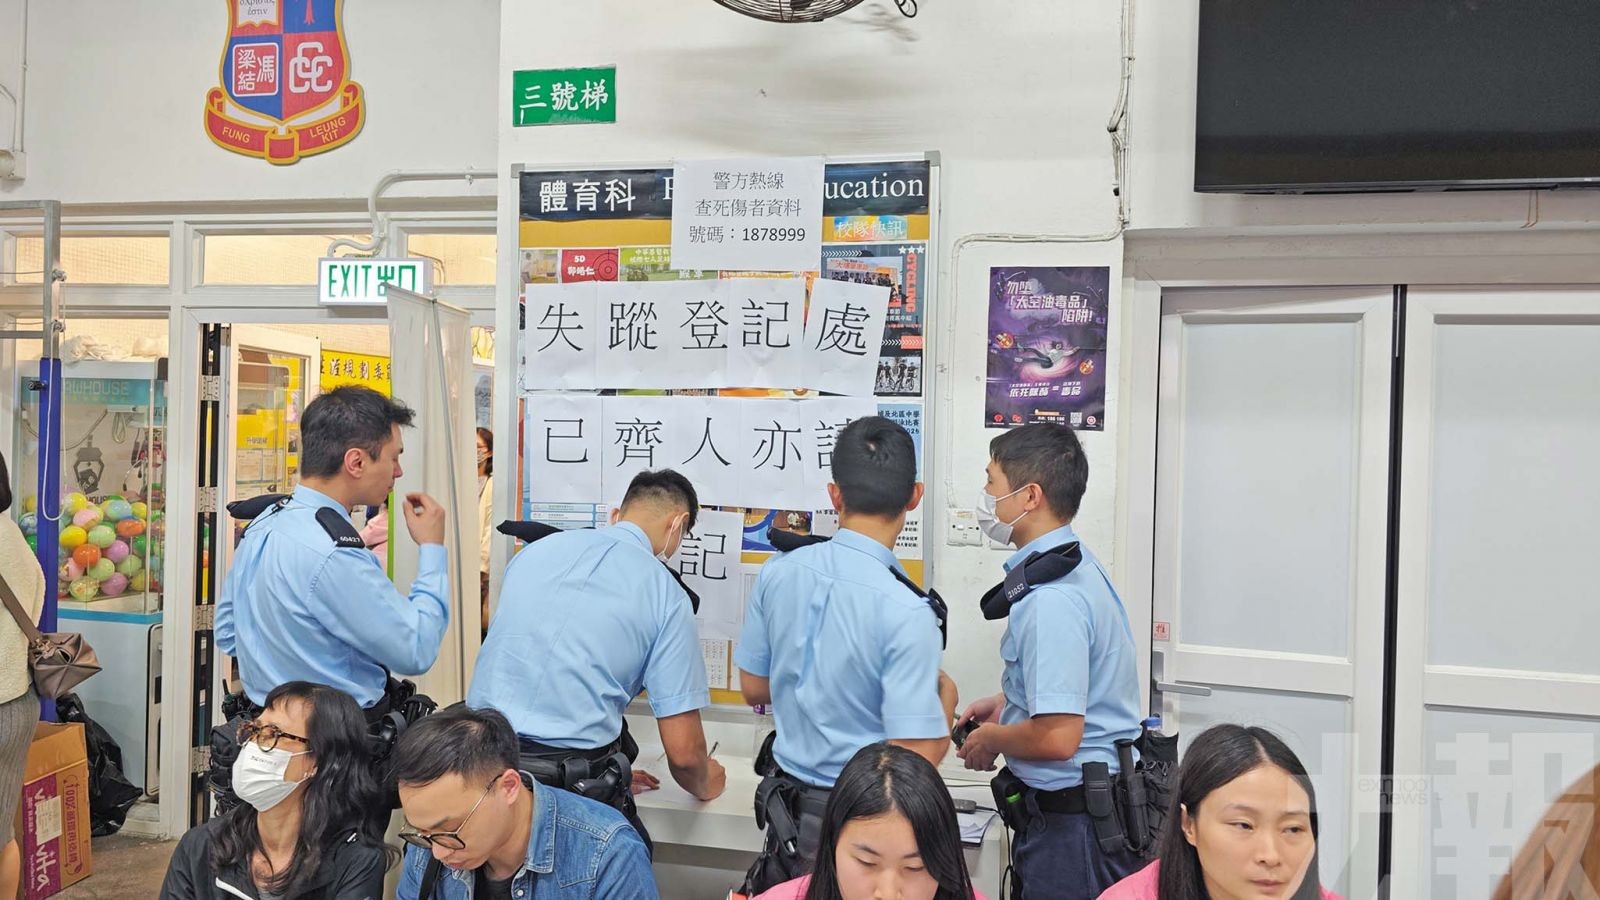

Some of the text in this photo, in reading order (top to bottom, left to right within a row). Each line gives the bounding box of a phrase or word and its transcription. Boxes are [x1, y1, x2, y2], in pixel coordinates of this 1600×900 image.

[519, 78, 609, 111] 三號梯
[222, 126, 251, 144] FUNG
[309, 116, 346, 138] LEUNG
[321, 129, 339, 144] KIT
[713, 171, 785, 190] 警方熱線
[539, 179, 637, 213] 體育科
[694, 198, 802, 218] 查死傷者資料
[688, 225, 807, 244] 號碼：1878999
[837, 220, 904, 238] 校隊快訊
[328, 264, 372, 297] EXIT
[906, 253, 917, 312] CYCLING
[537, 298, 871, 356] 失蹤登記處
[680, 532, 728, 580] 記
[1007, 583, 1025, 599] 21052
[36, 844, 57, 892] vita
